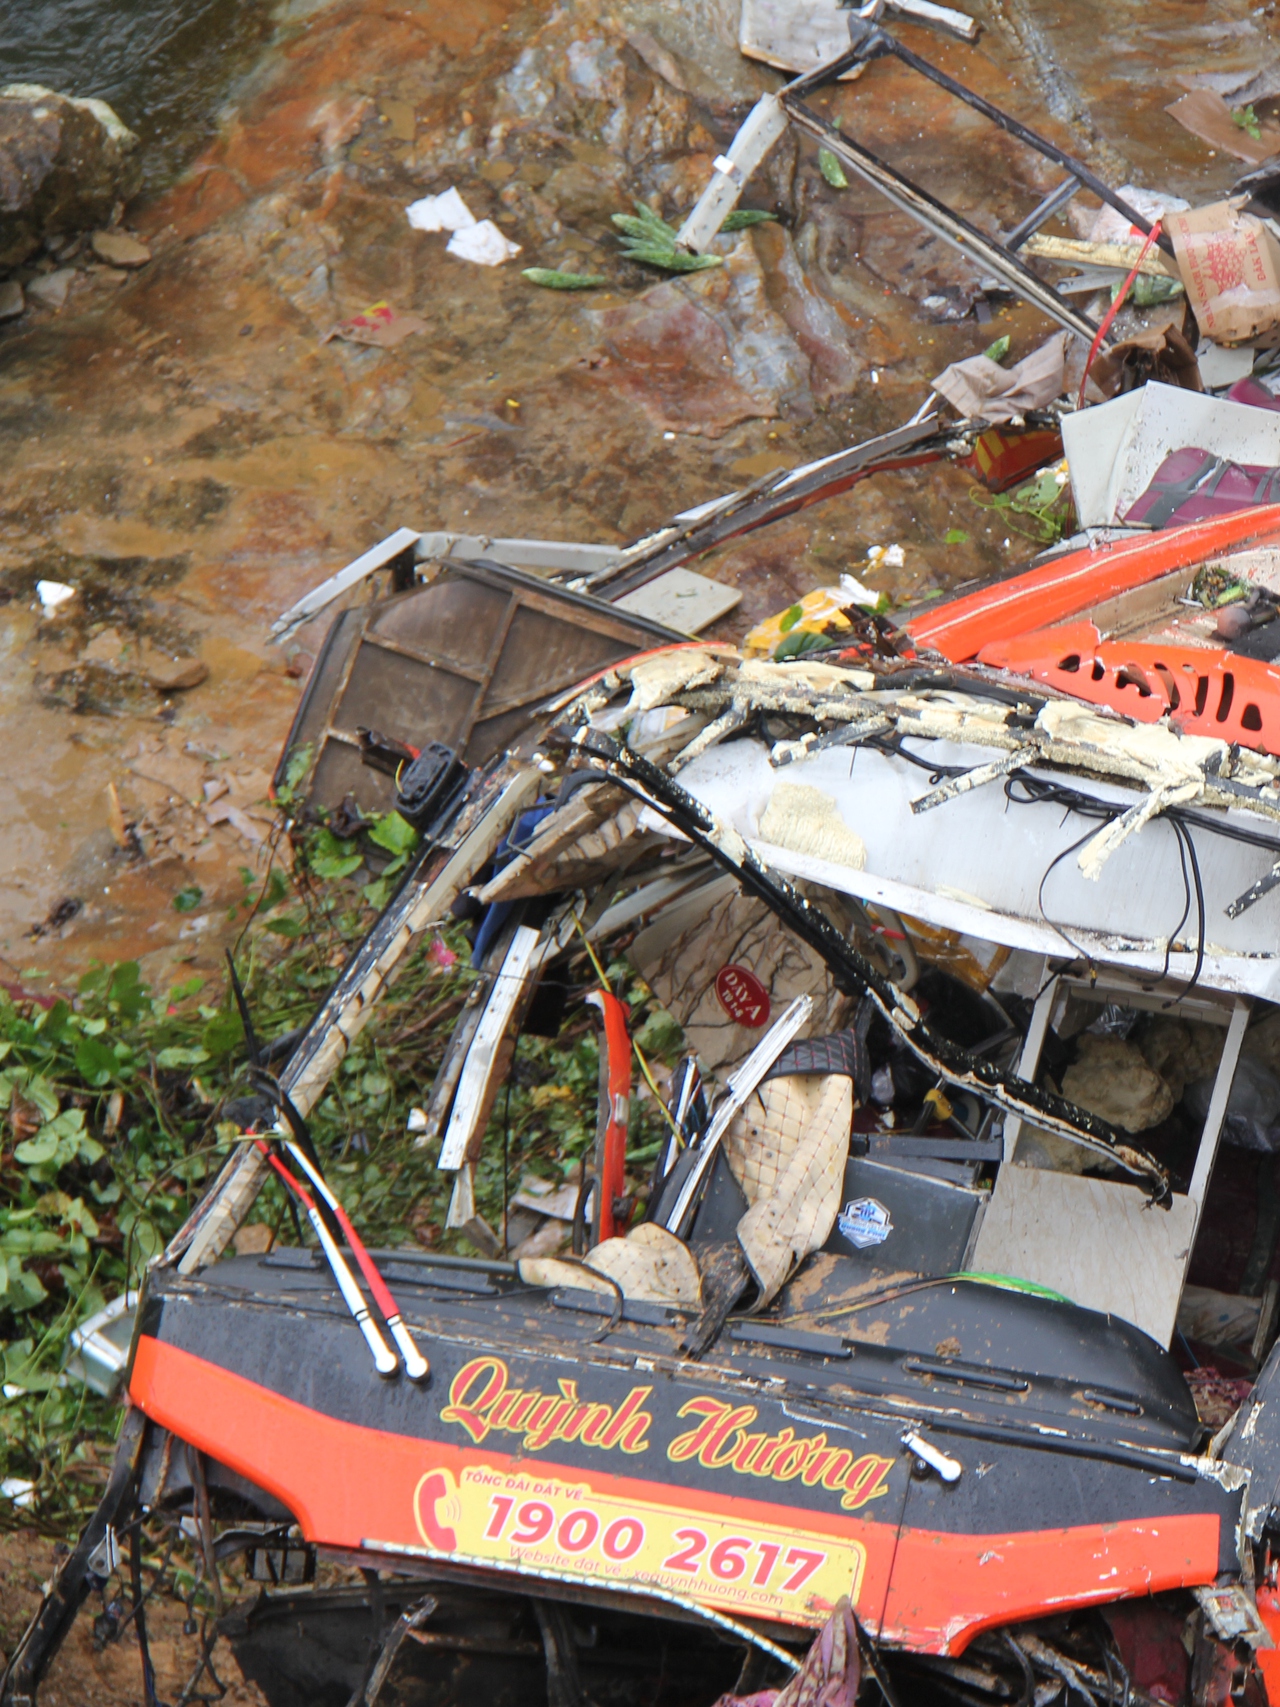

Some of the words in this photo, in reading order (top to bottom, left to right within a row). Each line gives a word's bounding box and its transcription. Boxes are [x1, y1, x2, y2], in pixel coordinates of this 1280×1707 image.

[745, 1005, 761, 1020] A
[440, 1356, 654, 1454] Quỳnh
[668, 1397, 896, 1510] Hương
[465, 1469, 501, 1486] TỔNG
[505, 1477, 531, 1492] ĐÀI
[533, 1482, 561, 1498] ĐẶT
[565, 1487, 583, 1500] VÉ
[482, 1494, 646, 1561] 1900
[663, 1527, 827, 1594] 2617
[509, 1546, 570, 1568] Website
[604, 1562, 621, 1576] vé
